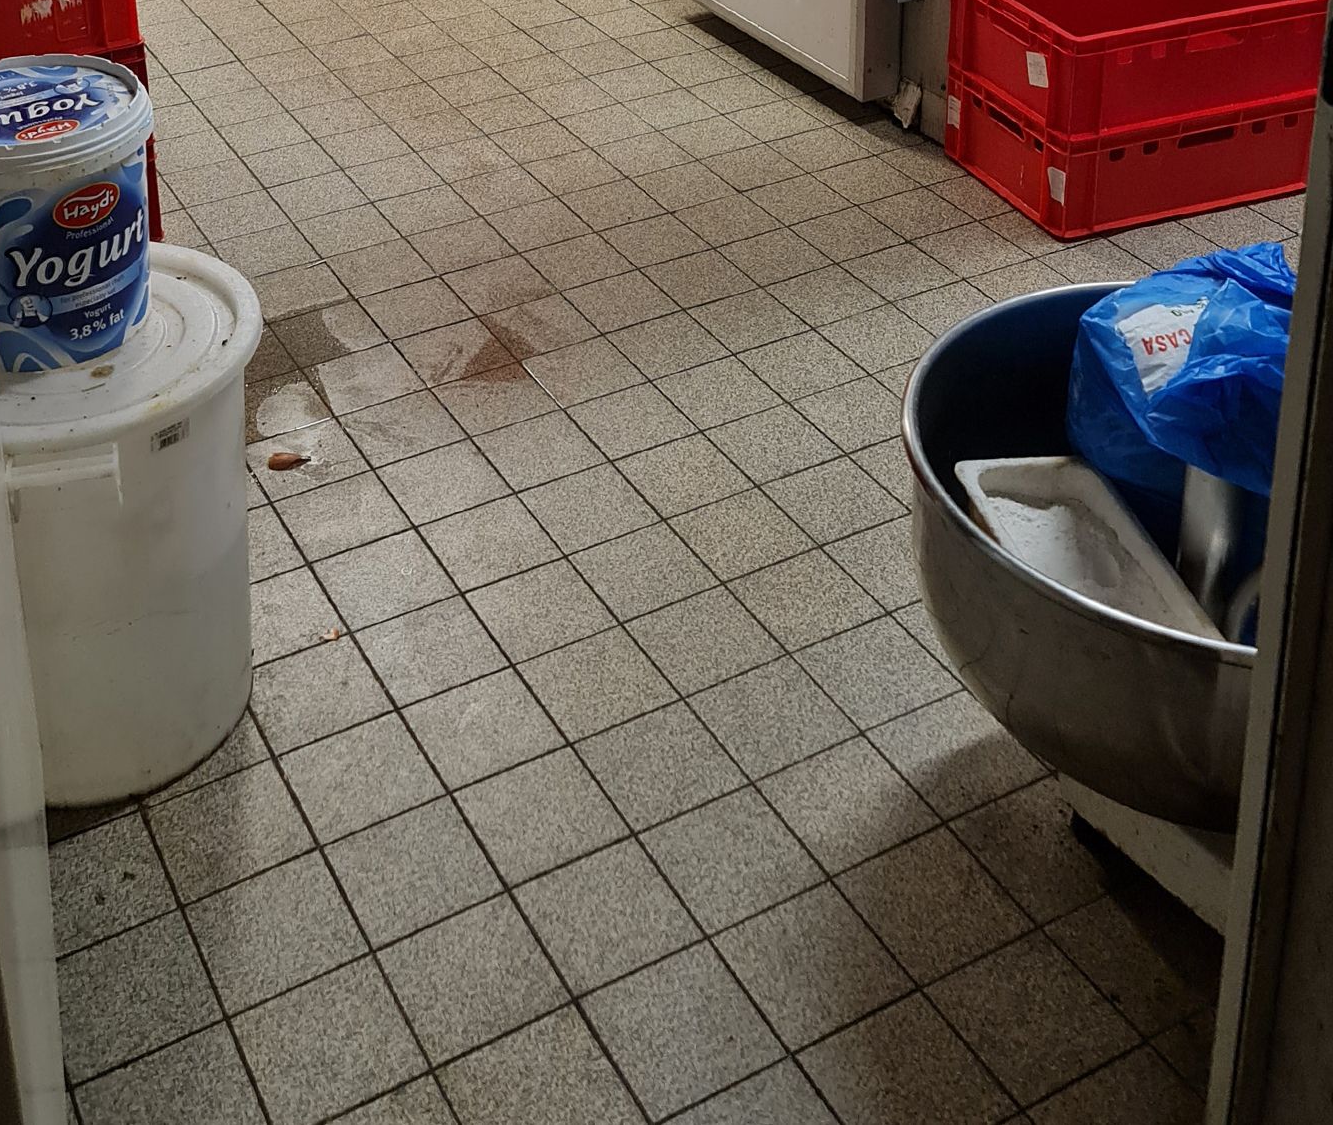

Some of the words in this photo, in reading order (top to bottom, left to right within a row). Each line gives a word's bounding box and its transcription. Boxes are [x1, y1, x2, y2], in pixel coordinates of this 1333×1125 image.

[63, 189, 115, 220] Haydi
[65, 217, 115, 240] Professional
[9, 208, 144, 287] Yogurt
[84, 303, 112, 319] Yogurt
[109, 308, 125, 326] fat
[1141, 328, 1192, 355] CASA
